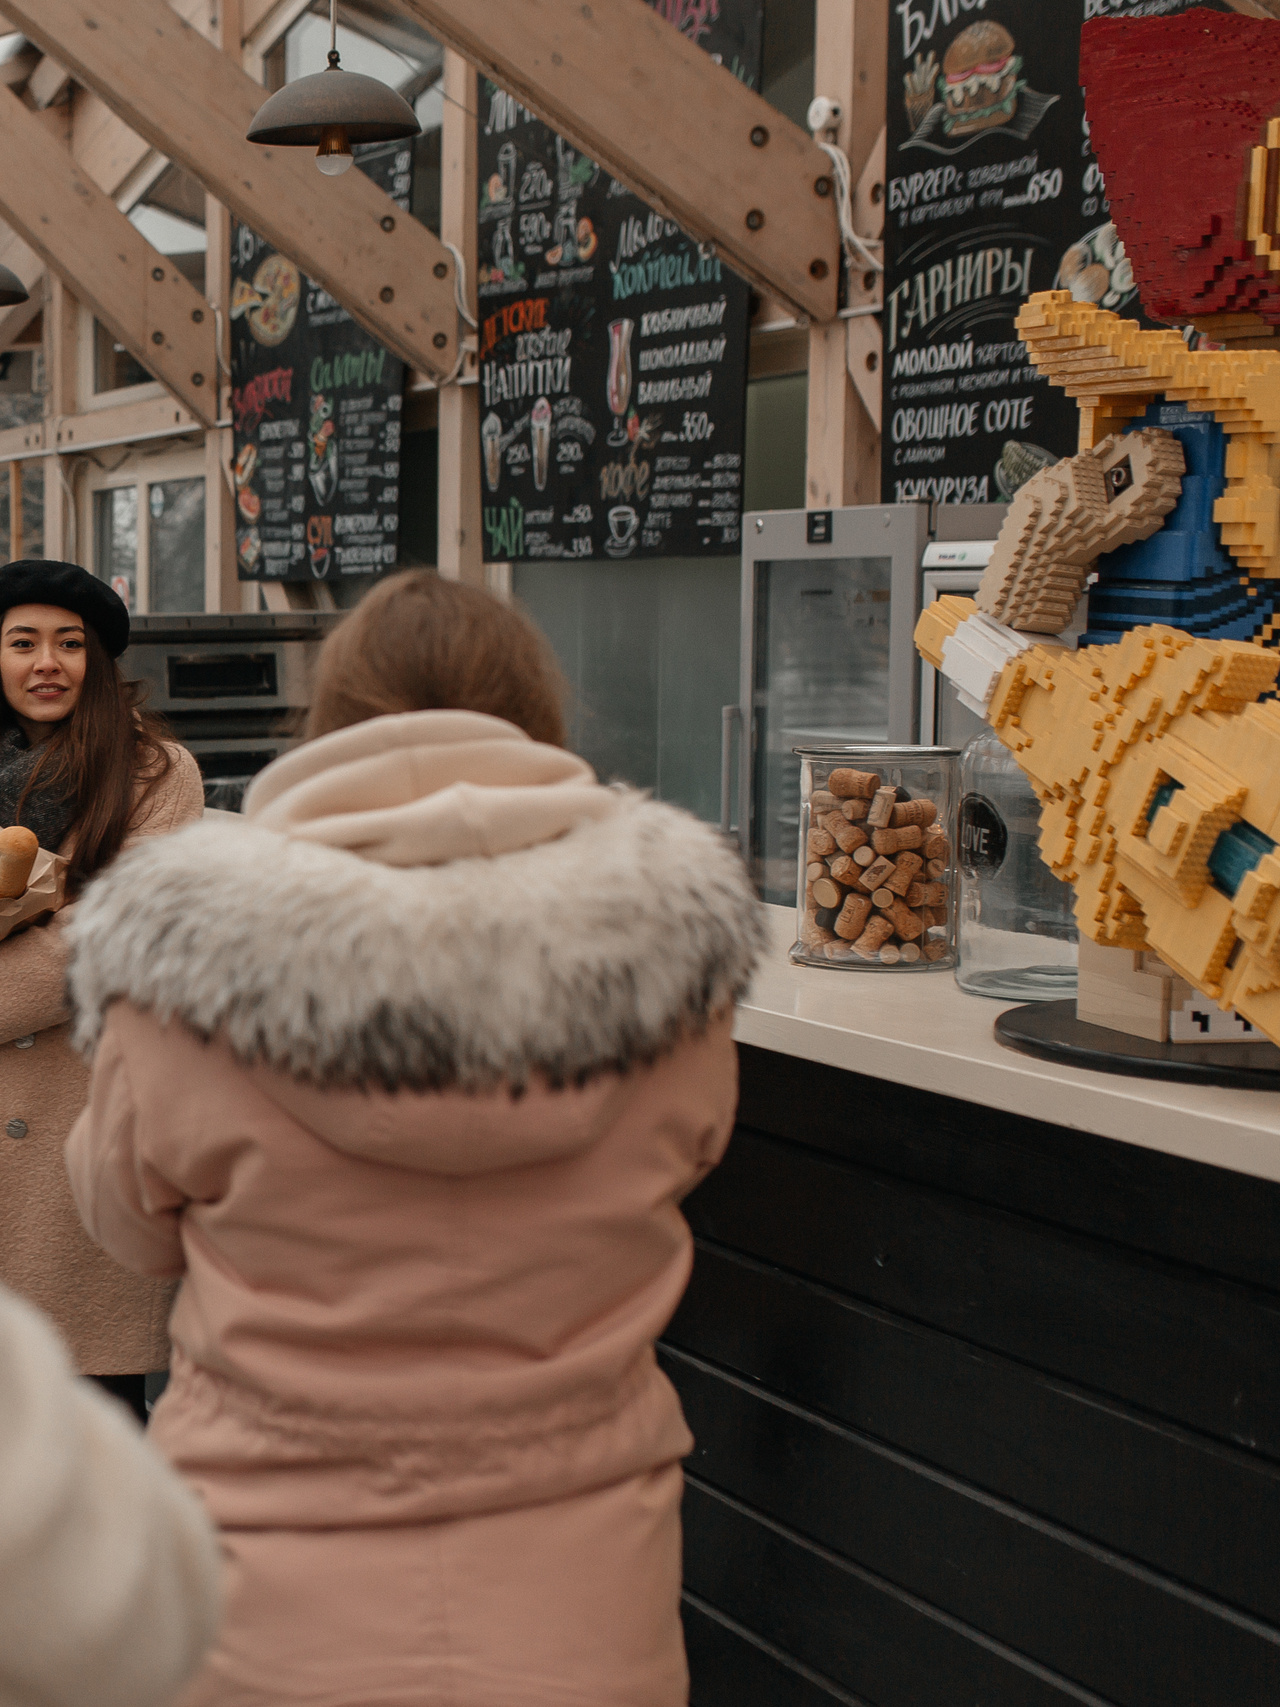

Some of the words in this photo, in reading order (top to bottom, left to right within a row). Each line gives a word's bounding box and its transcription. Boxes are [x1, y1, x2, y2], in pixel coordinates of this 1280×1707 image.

[888, 165, 957, 211] БУРГЕР
[1027, 167, 1063, 204] 650
[888, 248, 1033, 352] ГАРНИРЫ
[891, 333, 973, 379] МОЛОДОЙ
[891, 401, 981, 444] ОВОЩНОЕ
[984, 396, 1034, 433] СОТЕ
[894, 475, 989, 506] КУКУРУЗА
[484, 496, 524, 558] ЧАЙ
